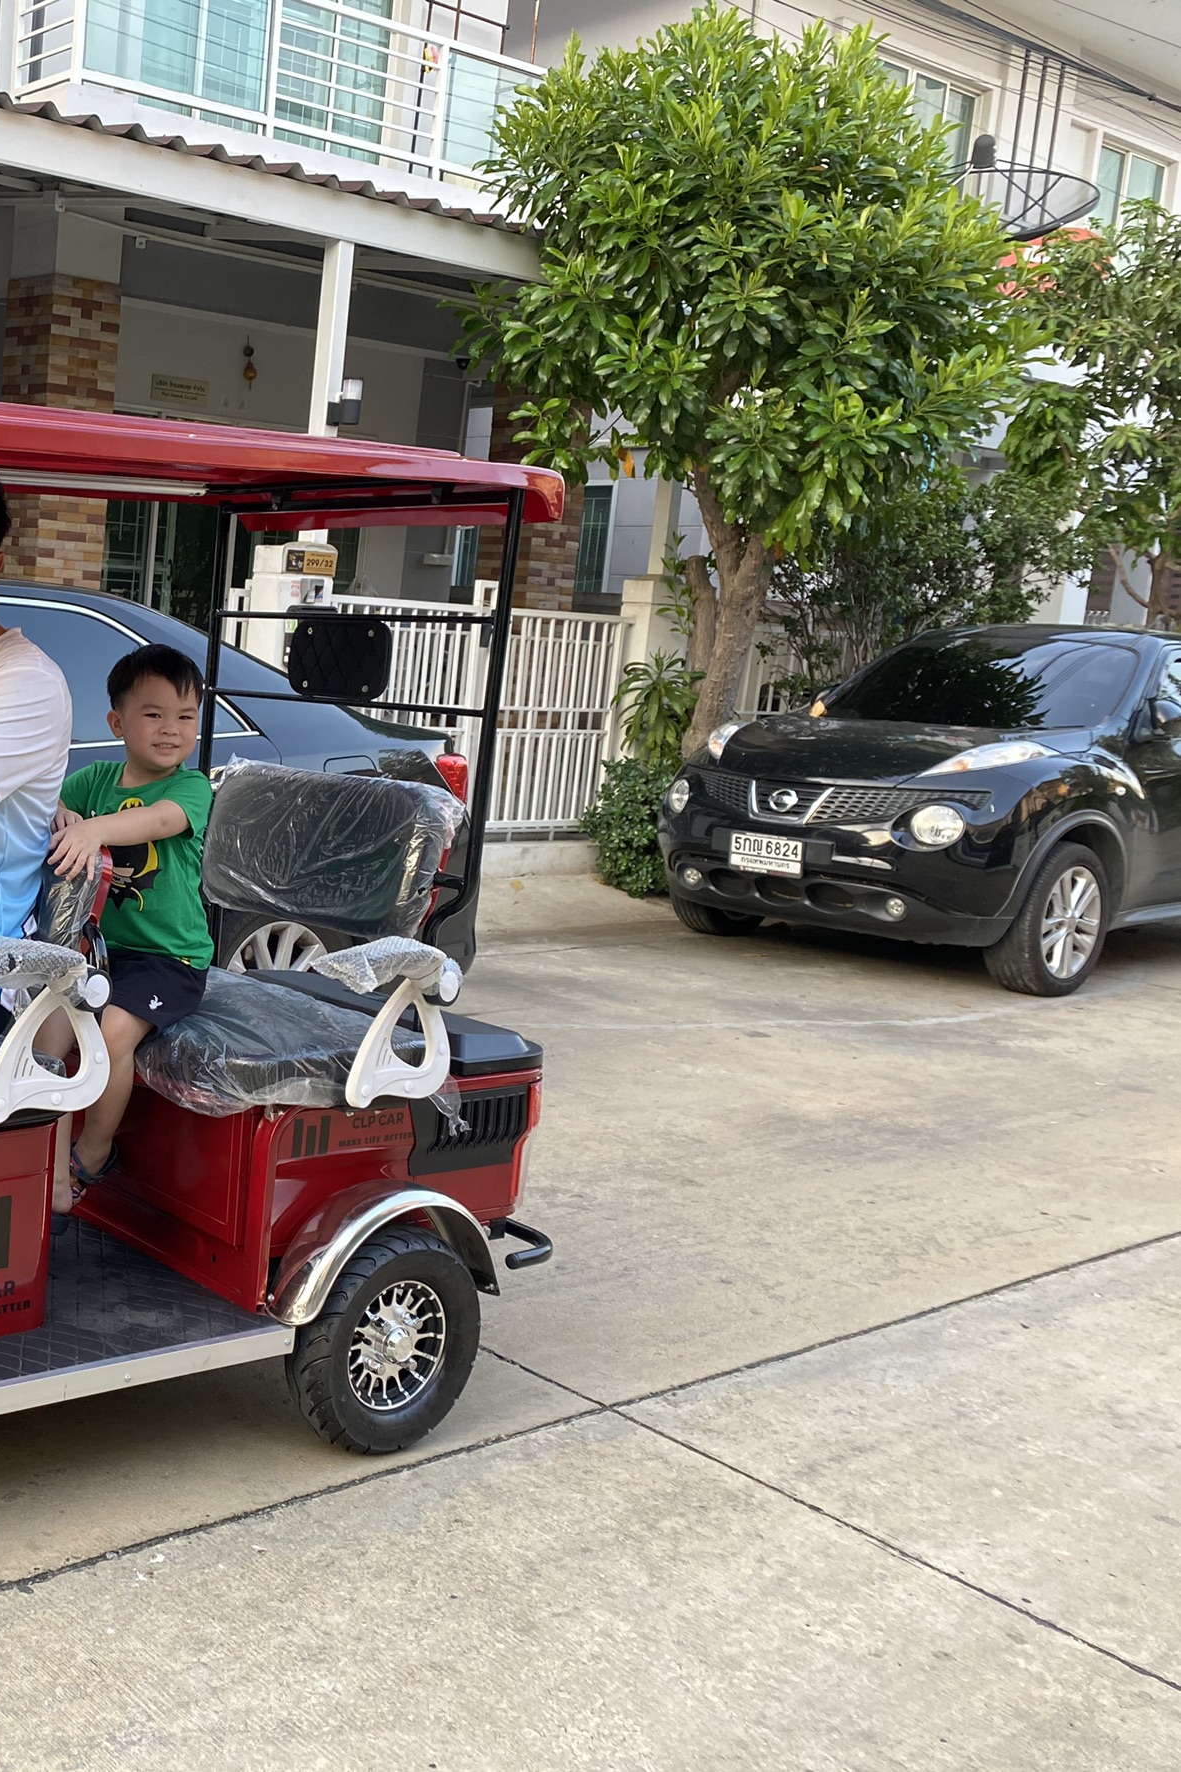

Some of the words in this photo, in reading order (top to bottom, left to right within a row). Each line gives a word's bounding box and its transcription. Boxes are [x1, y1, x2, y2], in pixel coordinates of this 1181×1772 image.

[306, 558, 334, 568] 299/32
[734, 836, 764, 855] 5กญ
[765, 840, 799, 858] 6824
[741, 856, 790, 869] กรุงเทพมหานคร
[352, 1115, 376, 1130] CLP
[379, 1112, 405, 1126] CAR
[339, 1138, 361, 1148] MAKE
[364, 1136, 380, 1145] LIFE
[384, 1131, 414, 1142] BETTER
